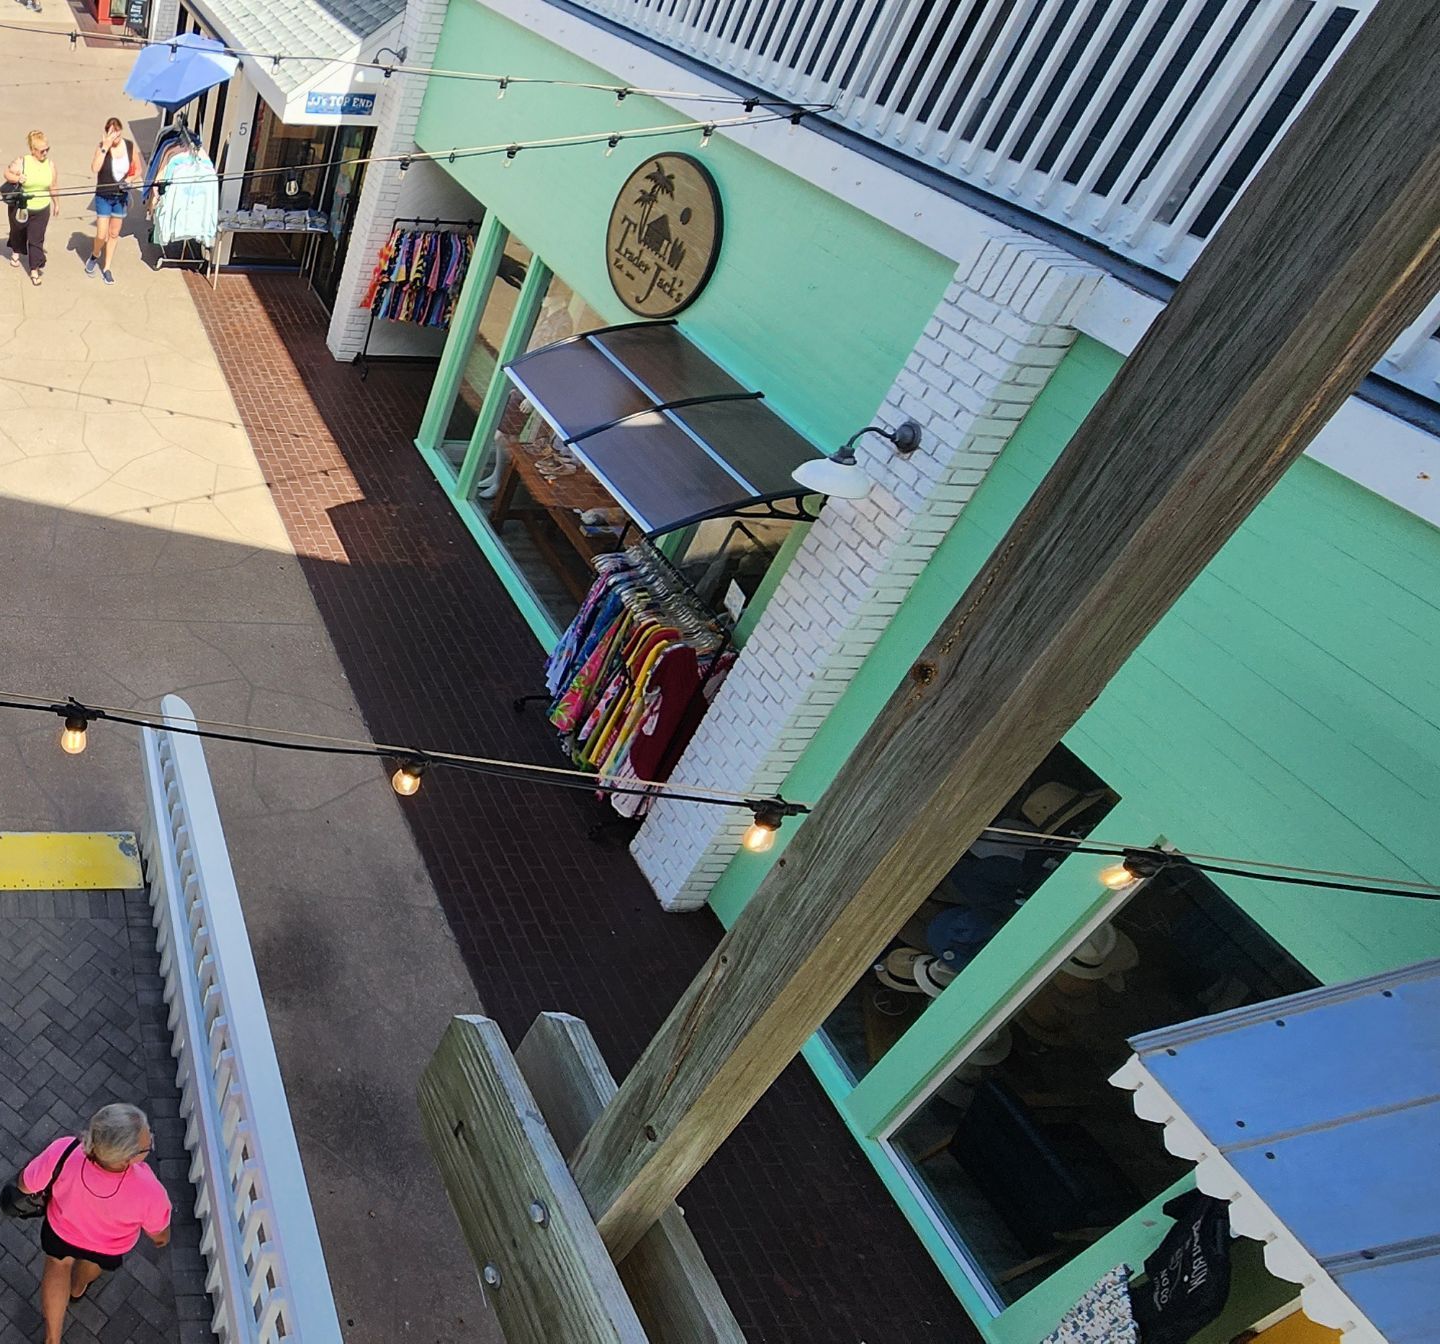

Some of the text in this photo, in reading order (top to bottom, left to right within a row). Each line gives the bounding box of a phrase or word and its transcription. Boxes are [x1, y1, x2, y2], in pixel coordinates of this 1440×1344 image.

[330, 95, 350, 107] TOP
[352, 97, 373, 108] END
[239, 122, 248, 136] 5
[615, 215, 651, 274] Trader
[635, 261, 684, 303] Jack's
